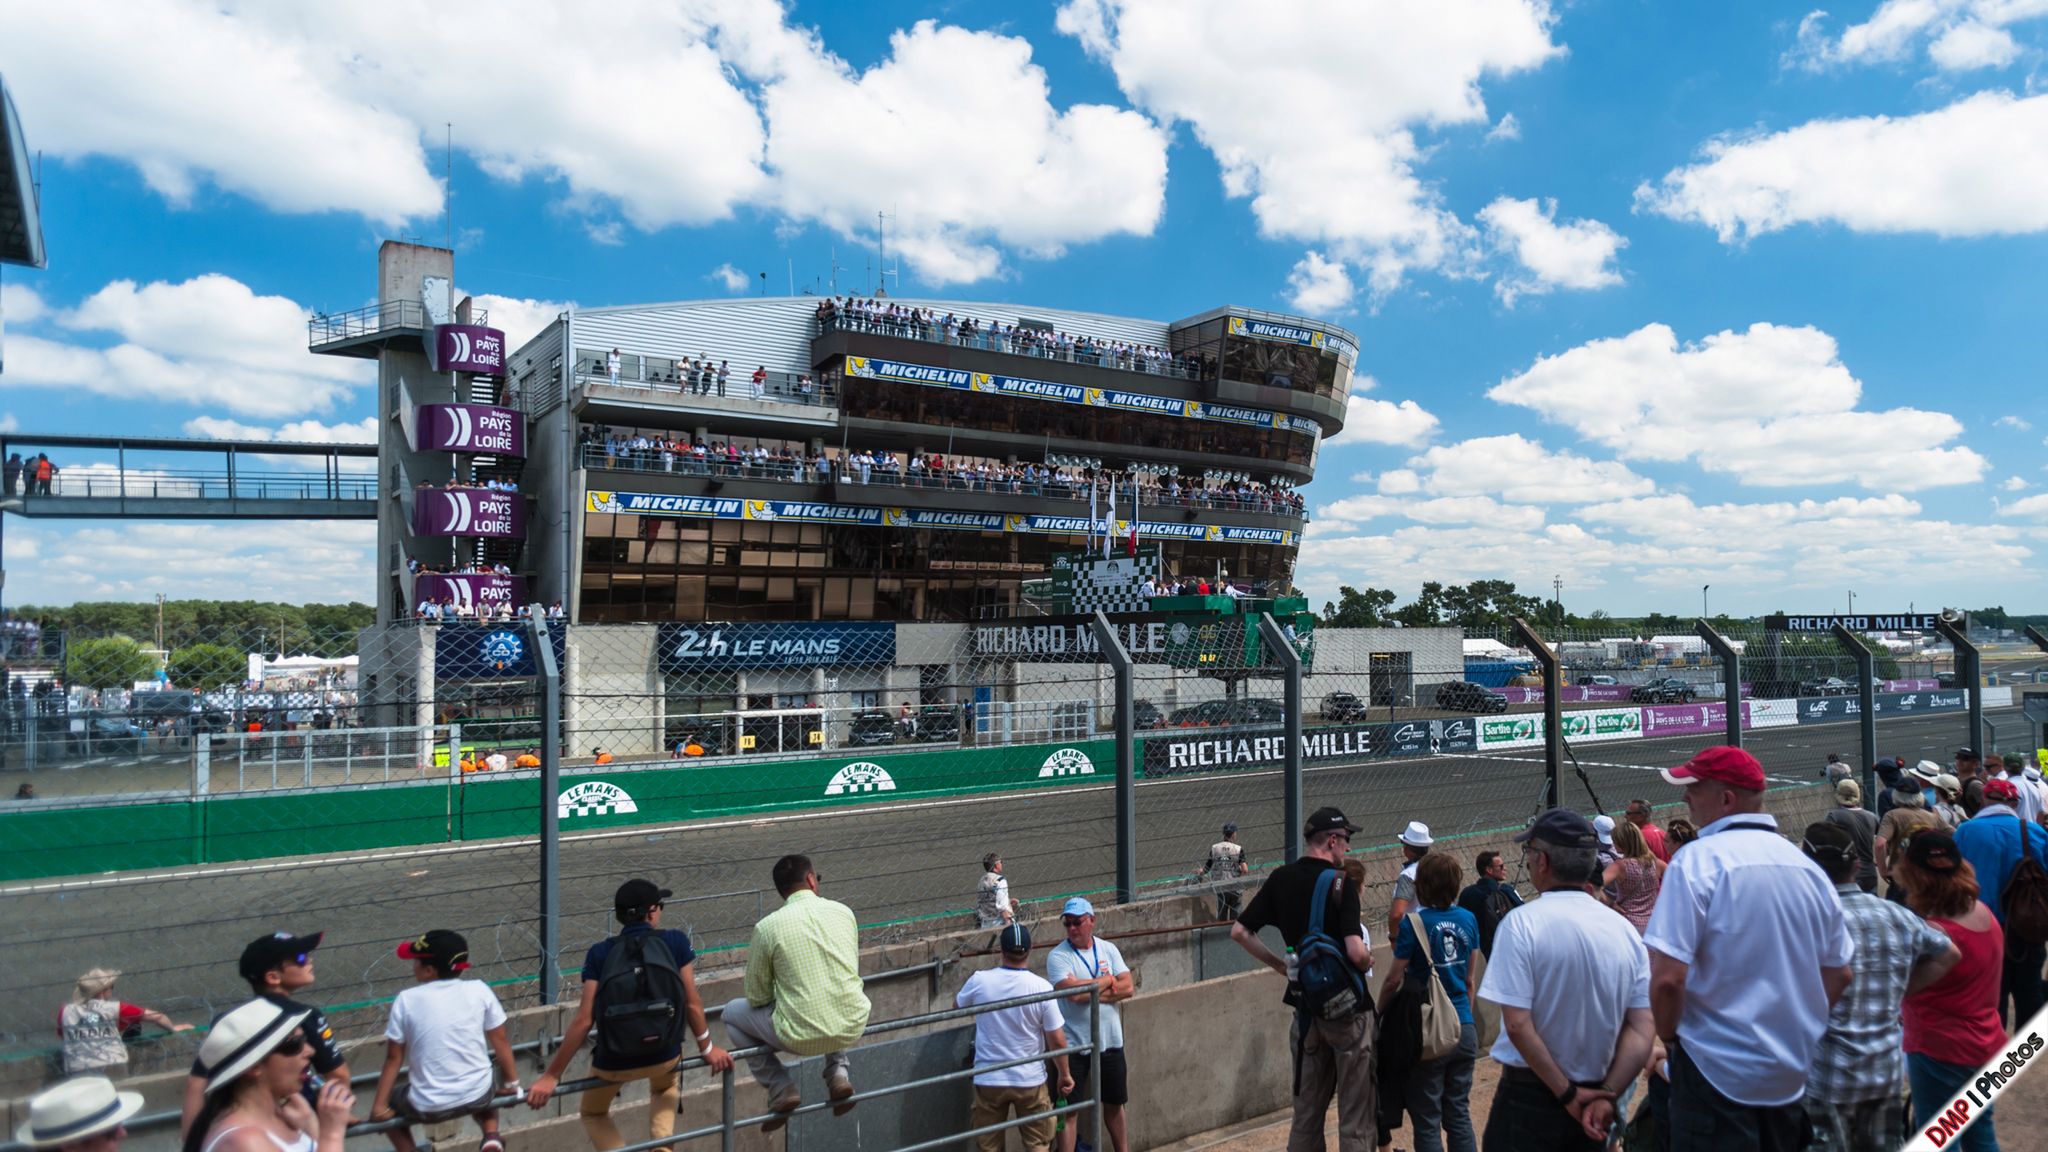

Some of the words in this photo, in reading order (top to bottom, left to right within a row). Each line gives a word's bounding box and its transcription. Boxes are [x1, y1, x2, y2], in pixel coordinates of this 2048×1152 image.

[1252, 324, 1311, 341] MICHELIN
[476, 340, 500, 352] PAYS
[472, 353, 500, 367] LOIRE
[880, 363, 968, 384] MICHELIN
[1003, 379, 1082, 398] MICHELIN
[1112, 394, 1182, 411] MICHELIN
[491, 411, 512, 419] Région
[1209, 406, 1273, 423] MICHELIN
[480, 416, 512, 431] PAYS
[475, 435, 512, 450] LOIRE
[491, 493, 511, 501] Région
[479, 501, 511, 514] PAYS
[630, 496, 739, 513] MICHELIN
[782, 504, 879, 520] MICHELIN
[917, 511, 1002, 526] MICHELIN
[474, 520, 511, 533] LOIRE
[1137, 524, 1205, 536] MICHELIN
[1228, 529, 1283, 541] MICHELIN
[480, 588, 512, 600] PAYS
[1788, 617, 1868, 630] RICHARD
[1876, 616, 1935, 629] MILLE
[977, 625, 1066, 653] RICHARD
[1076, 623, 1166, 653] MLLE
[733, 640, 766, 656] LE
[769, 639, 840, 655] MANS
[1597, 716, 1620, 727] Sarthe
[1485, 724, 1511, 735] Sarthe
[1051, 753, 1061, 763] LE
[1062, 749, 1084, 762] MANS
[1169, 736, 1285, 768] RICHARD
[1301, 731, 1371, 758] MILLE
[841, 766, 852, 778] LE
[854, 764, 882, 777] MANS
[567, 787, 581, 800] LE
[583, 783, 620, 798] MANS
